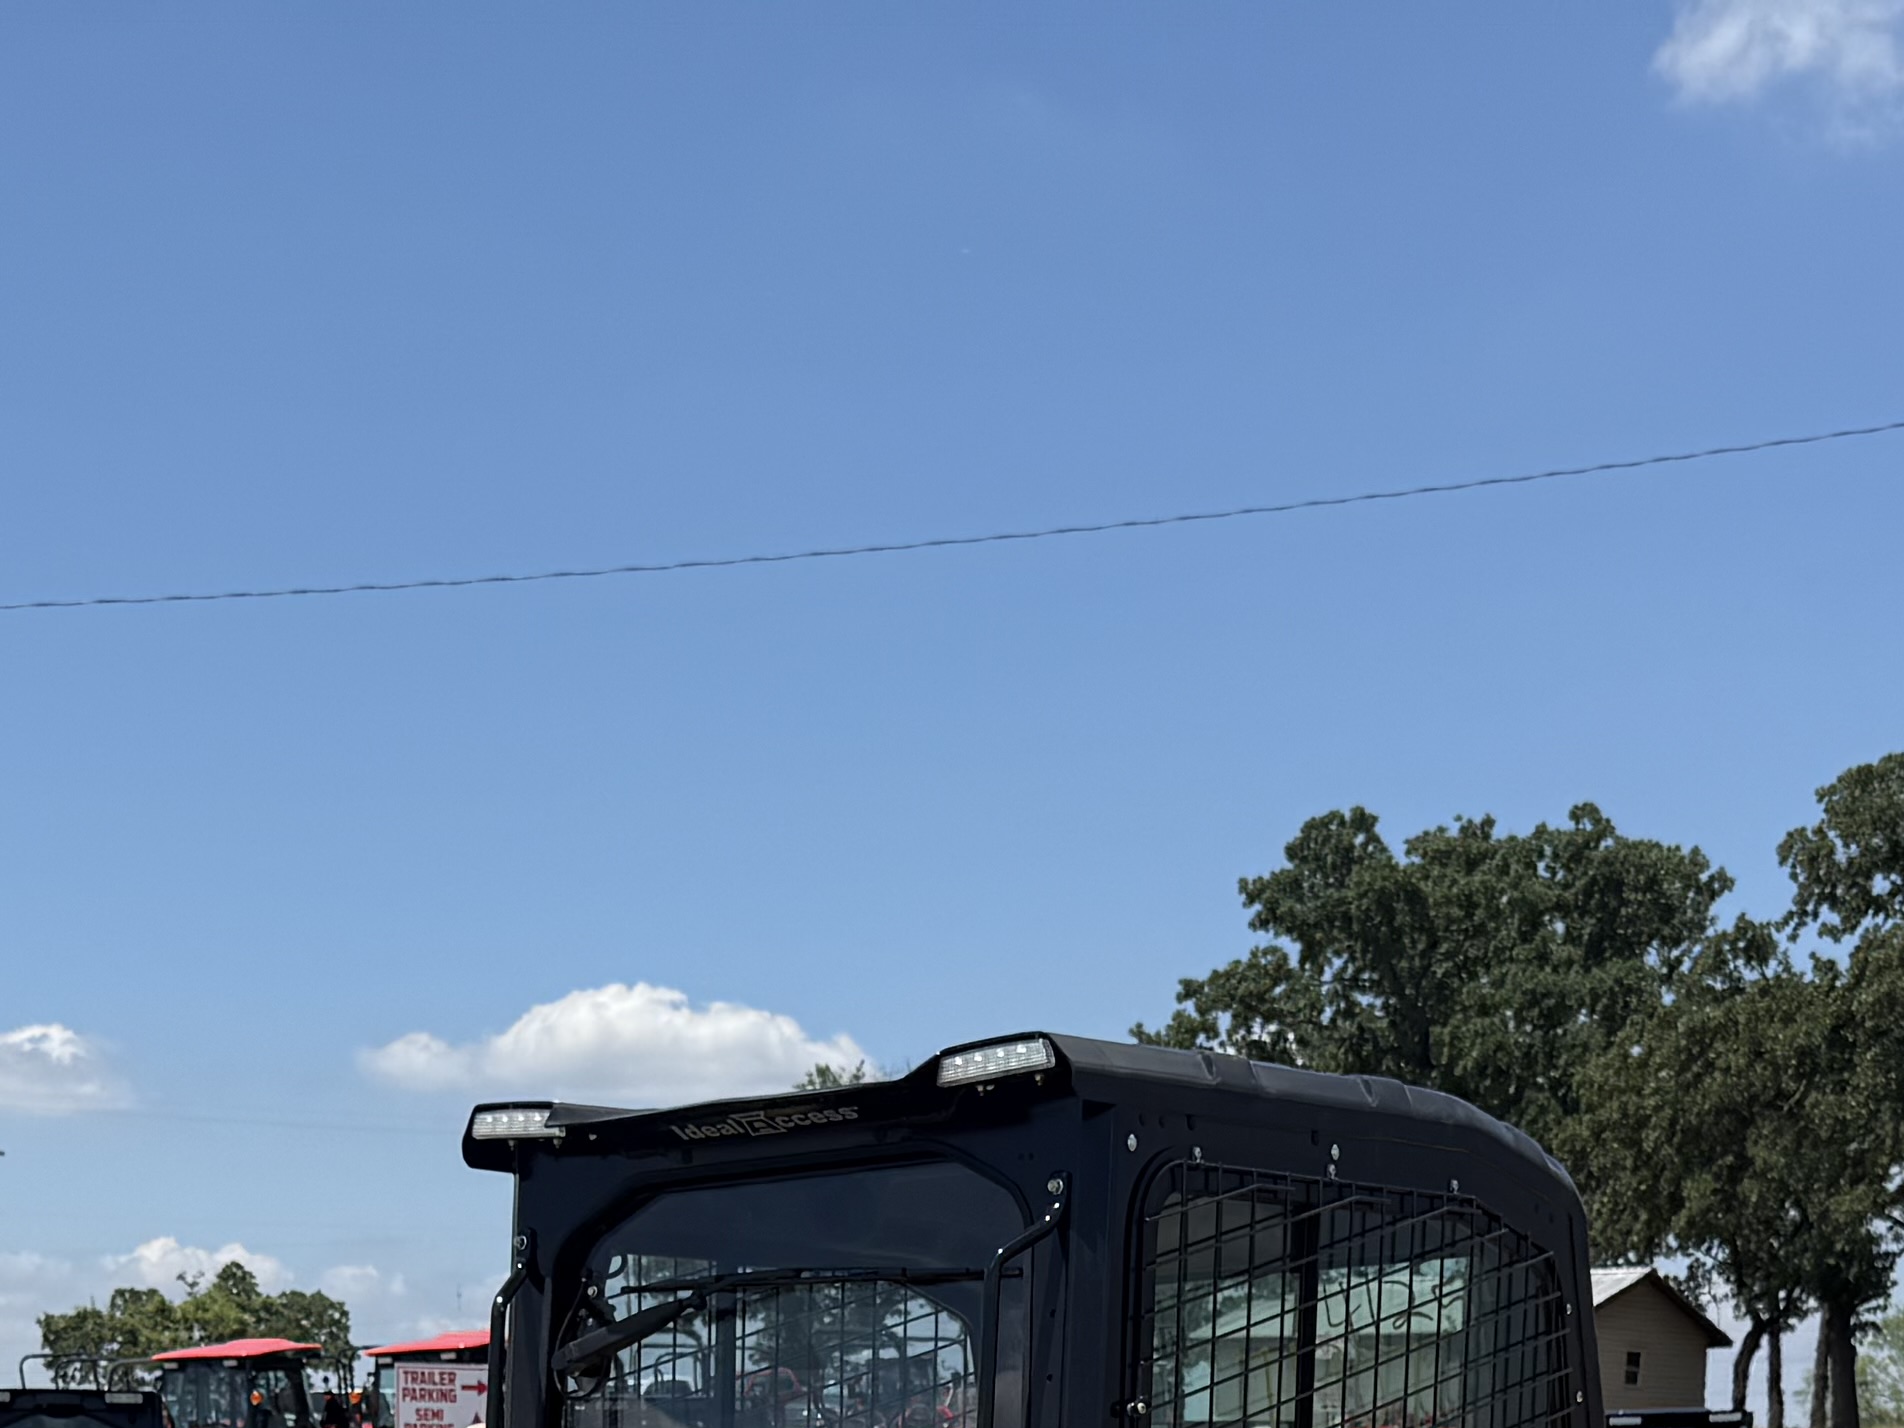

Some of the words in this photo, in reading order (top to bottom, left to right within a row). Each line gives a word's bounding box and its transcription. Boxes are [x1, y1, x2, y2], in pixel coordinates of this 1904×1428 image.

[403, 1371, 457, 1386] TRAILER
[402, 1387, 457, 1403] PARKING
[415, 1409, 444, 1422] SEMI
